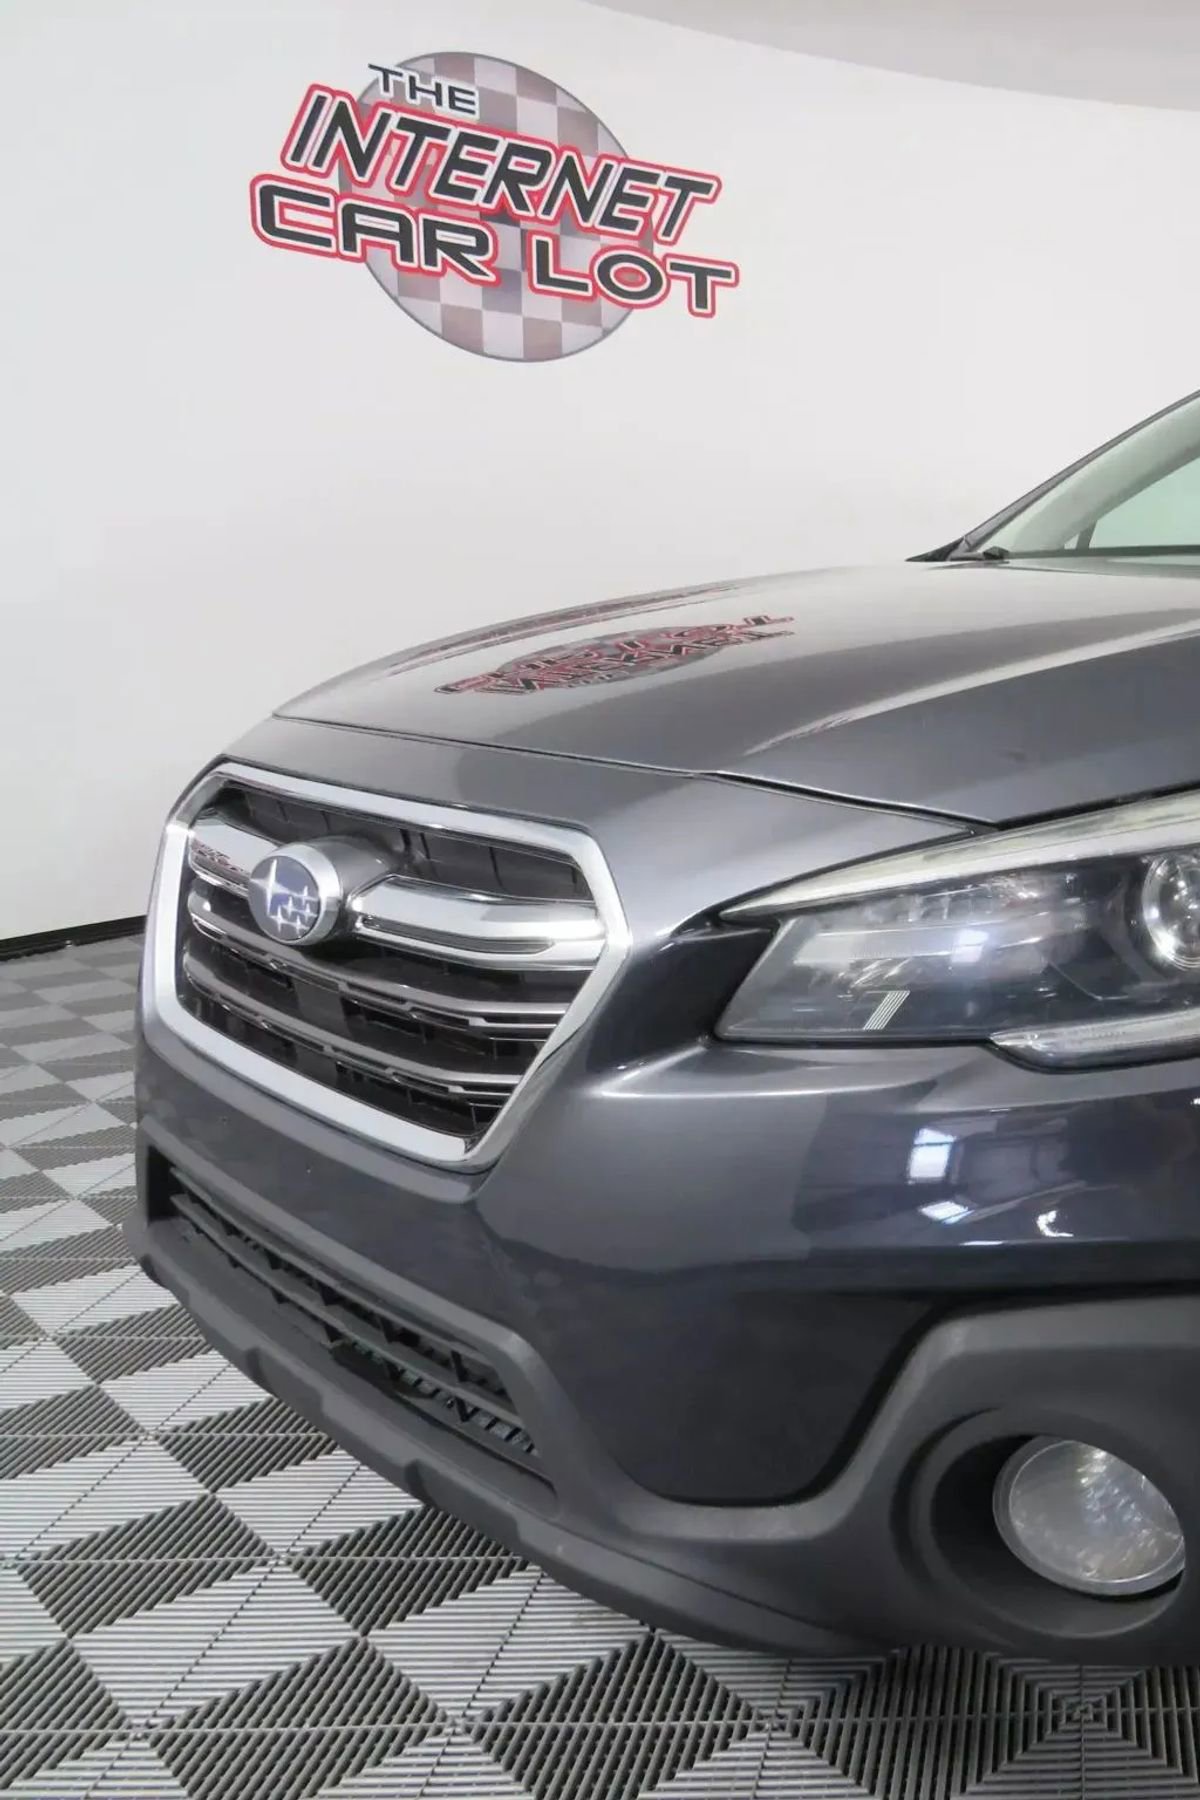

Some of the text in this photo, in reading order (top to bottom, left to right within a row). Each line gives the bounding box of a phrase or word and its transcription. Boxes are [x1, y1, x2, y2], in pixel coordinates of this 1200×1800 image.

[366, 62, 478, 116] THE
[286, 90, 717, 241] INTERNET
[256, 182, 734, 311] CAR LOT
